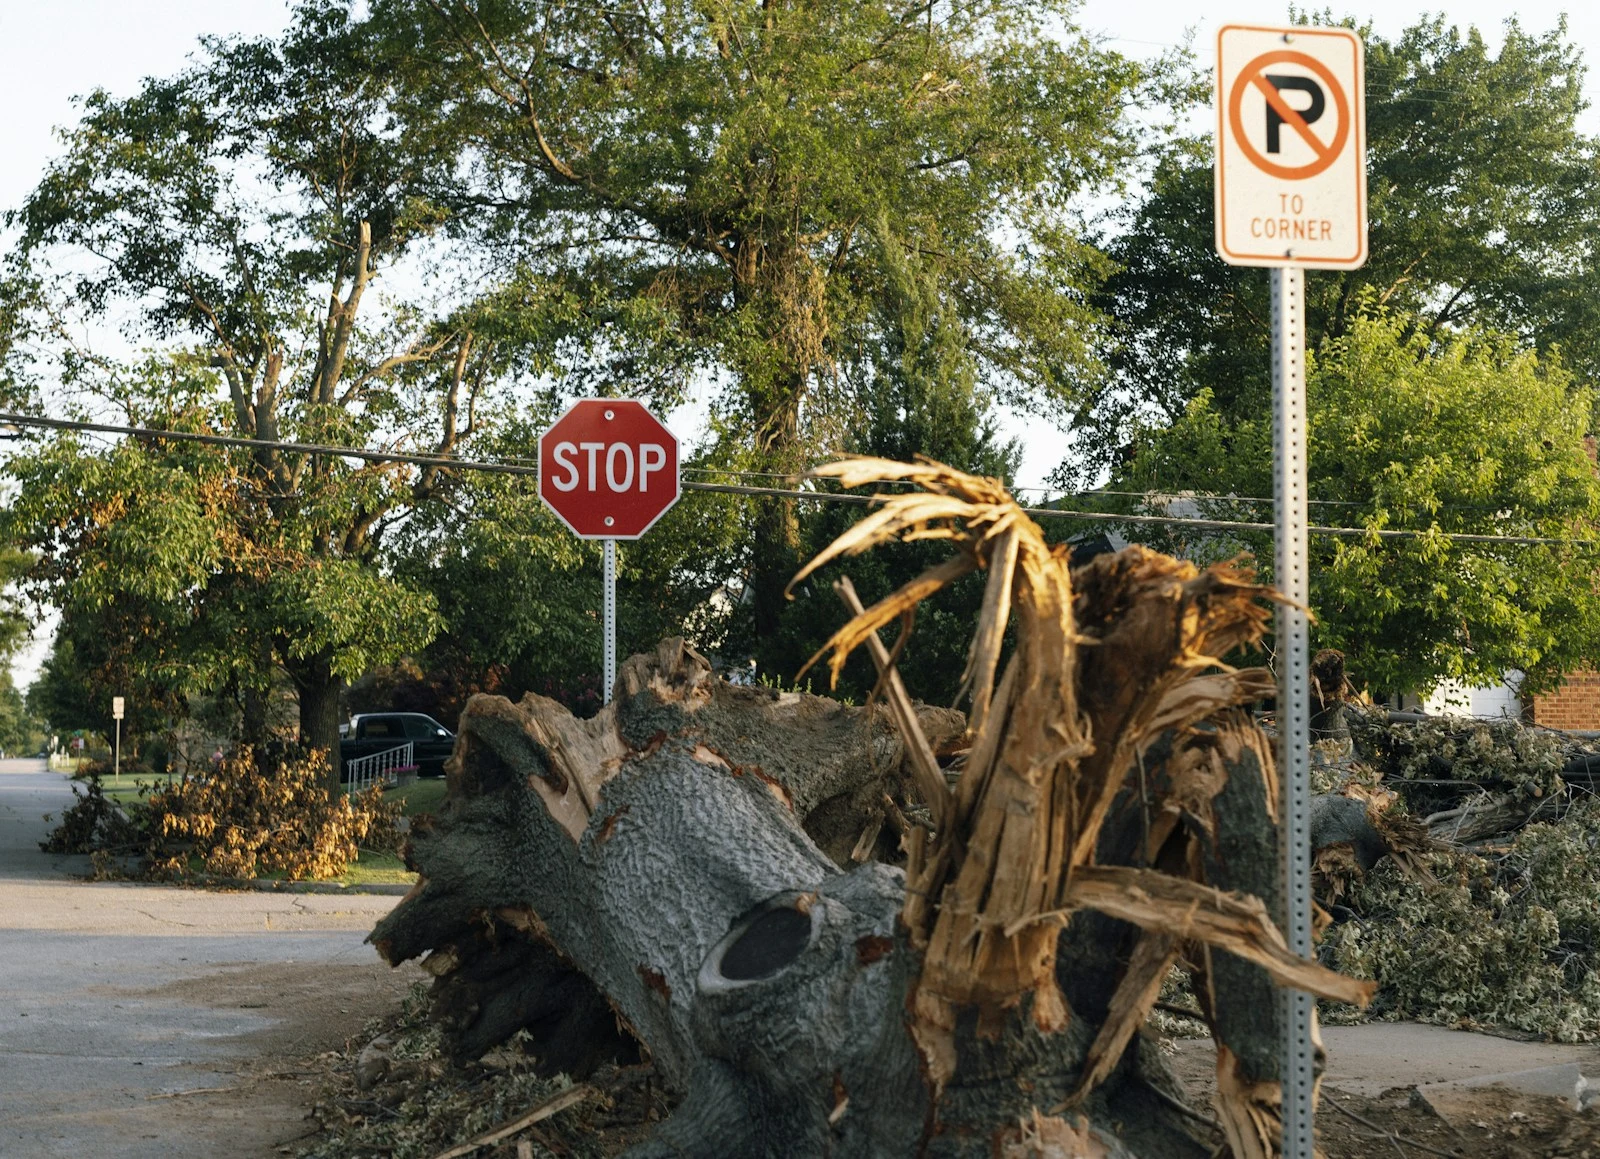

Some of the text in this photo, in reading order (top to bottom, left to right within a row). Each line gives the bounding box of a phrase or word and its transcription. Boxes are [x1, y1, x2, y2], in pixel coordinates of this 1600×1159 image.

[1266, 74, 1325, 153] P
[1279, 194, 1303, 214] TO
[1251, 217, 1332, 240] CORNER
[552, 441, 666, 492] STOP
